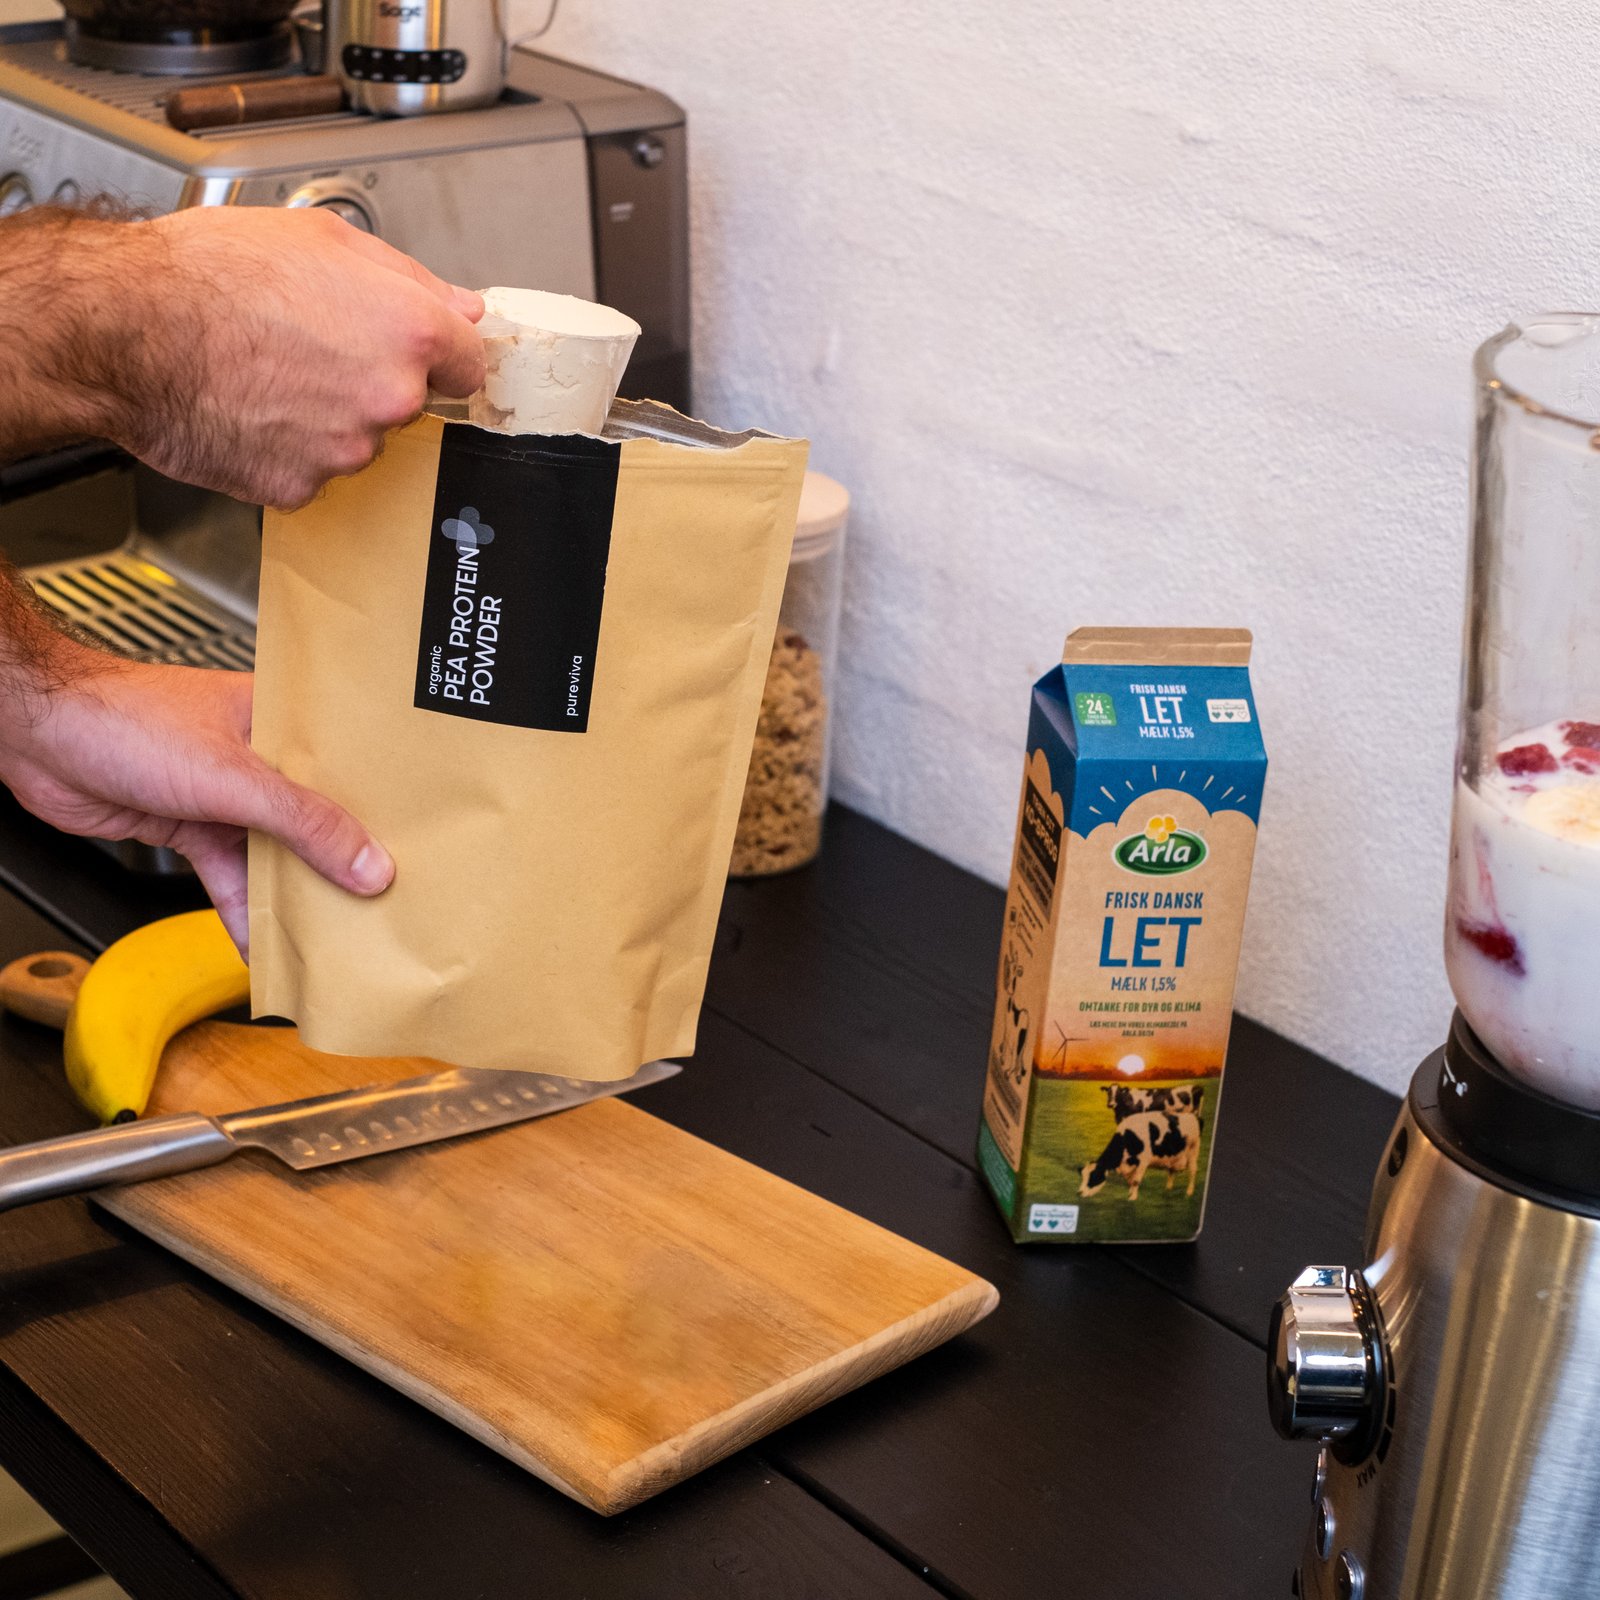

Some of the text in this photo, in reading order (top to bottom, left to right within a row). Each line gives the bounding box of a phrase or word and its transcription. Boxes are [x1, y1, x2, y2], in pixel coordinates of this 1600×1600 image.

[443, 546, 480, 700] PEA PROTEIN
[470, 596, 502, 705] POWDER
[428, 645, 442, 695] organic
[567, 655, 583, 716] pureviva
[1130, 684, 1187, 694] FRISK DANSK
[1086, 699, 1104, 714] 24
[1140, 696, 1183, 724] LET
[1139, 726, 1195, 739] MÆLK 1,5%
[1128, 838, 1192, 863] Arla
[1105, 892, 1204, 909] FRISK DANSK
[1099, 916, 1203, 968] LET
[1111, 977, 1176, 993] MÆLK 1,5%
[1079, 1001, 1121, 1012] OMTANKE
[1122, 1002, 1140, 1013] FOR
[1161, 1002, 1173, 1012] OG
[1174, 1002, 1202, 1012] KLIMA
[1356, 1460, 1377, 1488] MAX
